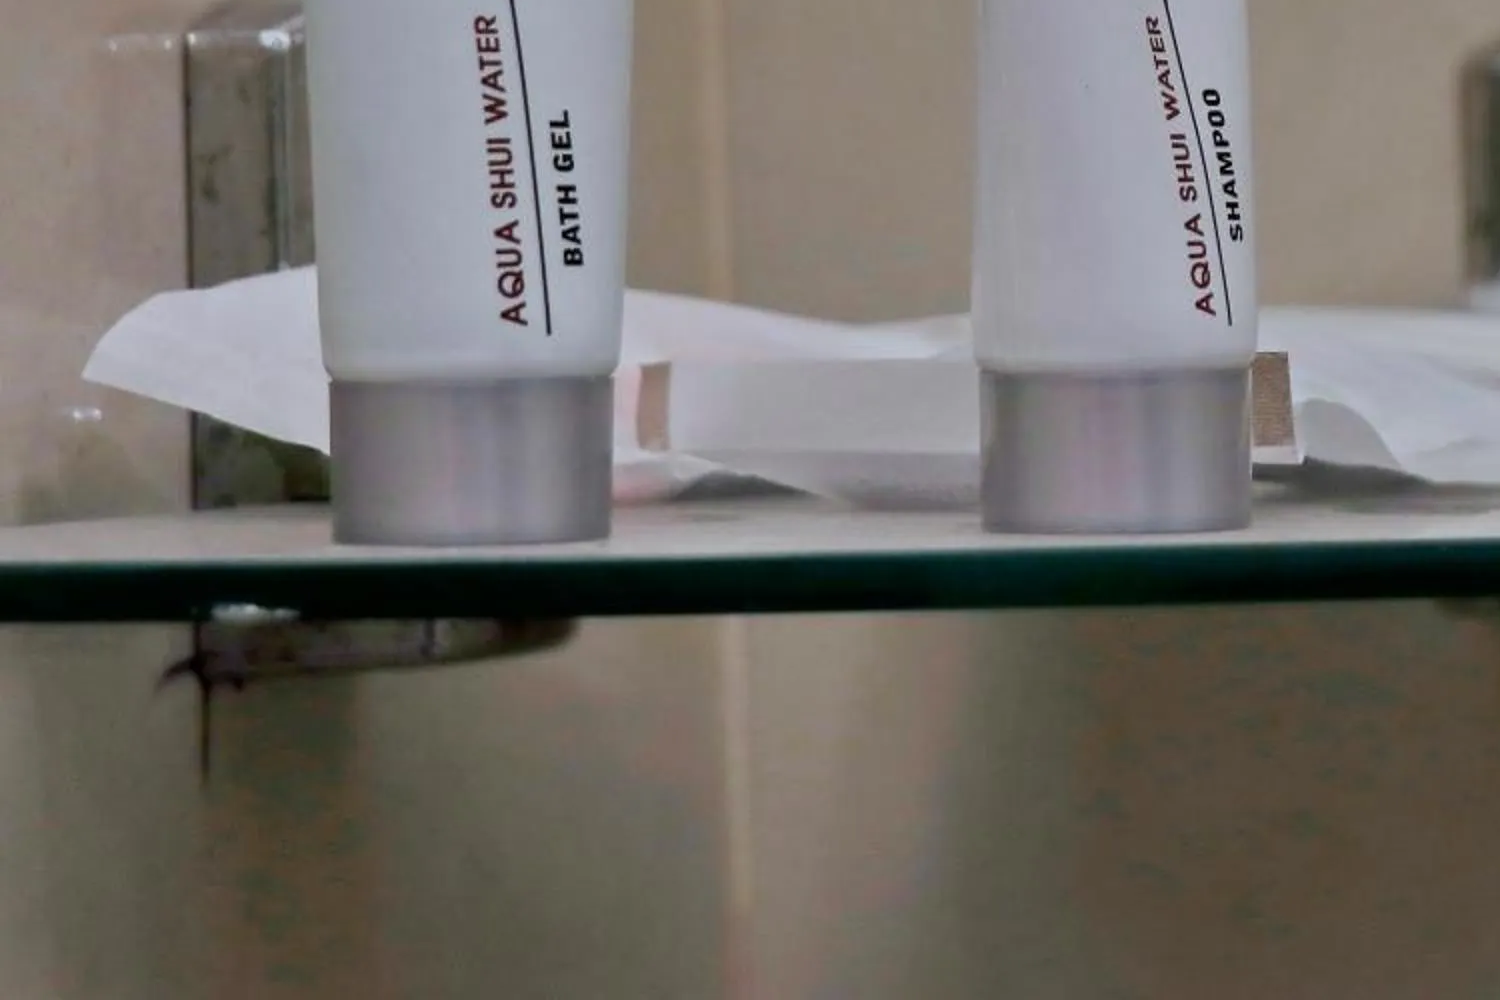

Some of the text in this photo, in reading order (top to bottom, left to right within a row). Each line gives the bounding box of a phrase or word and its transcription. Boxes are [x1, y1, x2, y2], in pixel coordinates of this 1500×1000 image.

[474, 14, 528, 326] AQUA SHUI WATER
[549, 109, 584, 266] BATH GEL
[1145, 16, 1217, 317] AQUA SHUI WATER
[1202, 88, 1244, 242] SHAMPOO
